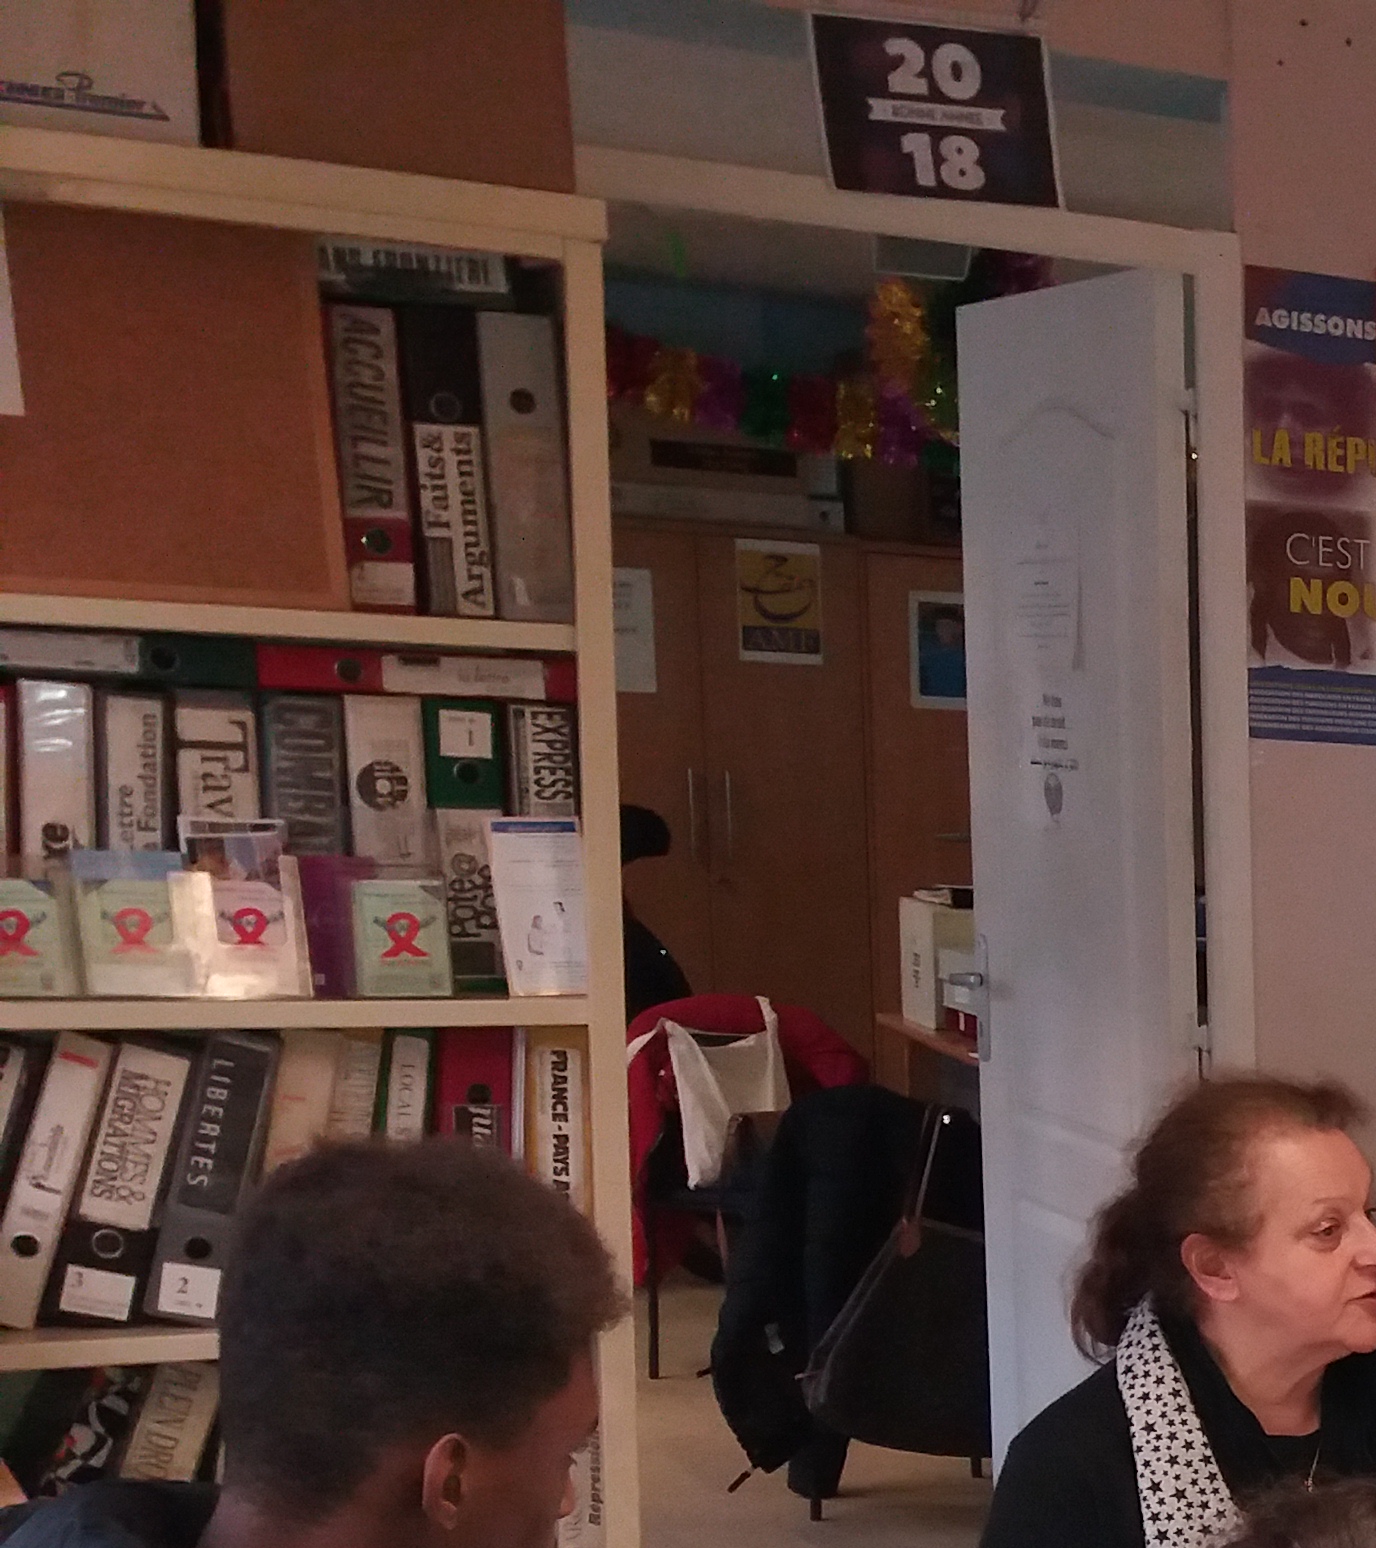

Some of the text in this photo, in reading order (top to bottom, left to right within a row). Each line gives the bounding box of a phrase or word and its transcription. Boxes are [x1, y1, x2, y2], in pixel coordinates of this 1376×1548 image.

[884, 36, 983, 100] 20
[901, 132, 987, 191] 18
[1255, 306, 1376, 342] AGISSONS
[340, 311, 395, 511] ACCUEILLIR
[1251, 426, 1293, 469] LA
[451, 429, 489, 609] Arguments
[1285, 531, 1371, 571] C'EST
[136, 712, 158, 833] Fondation
[176, 719, 250, 817] Trav
[530, 709, 573, 801] EXPRESS
[176, 1276, 189, 1294] 2
